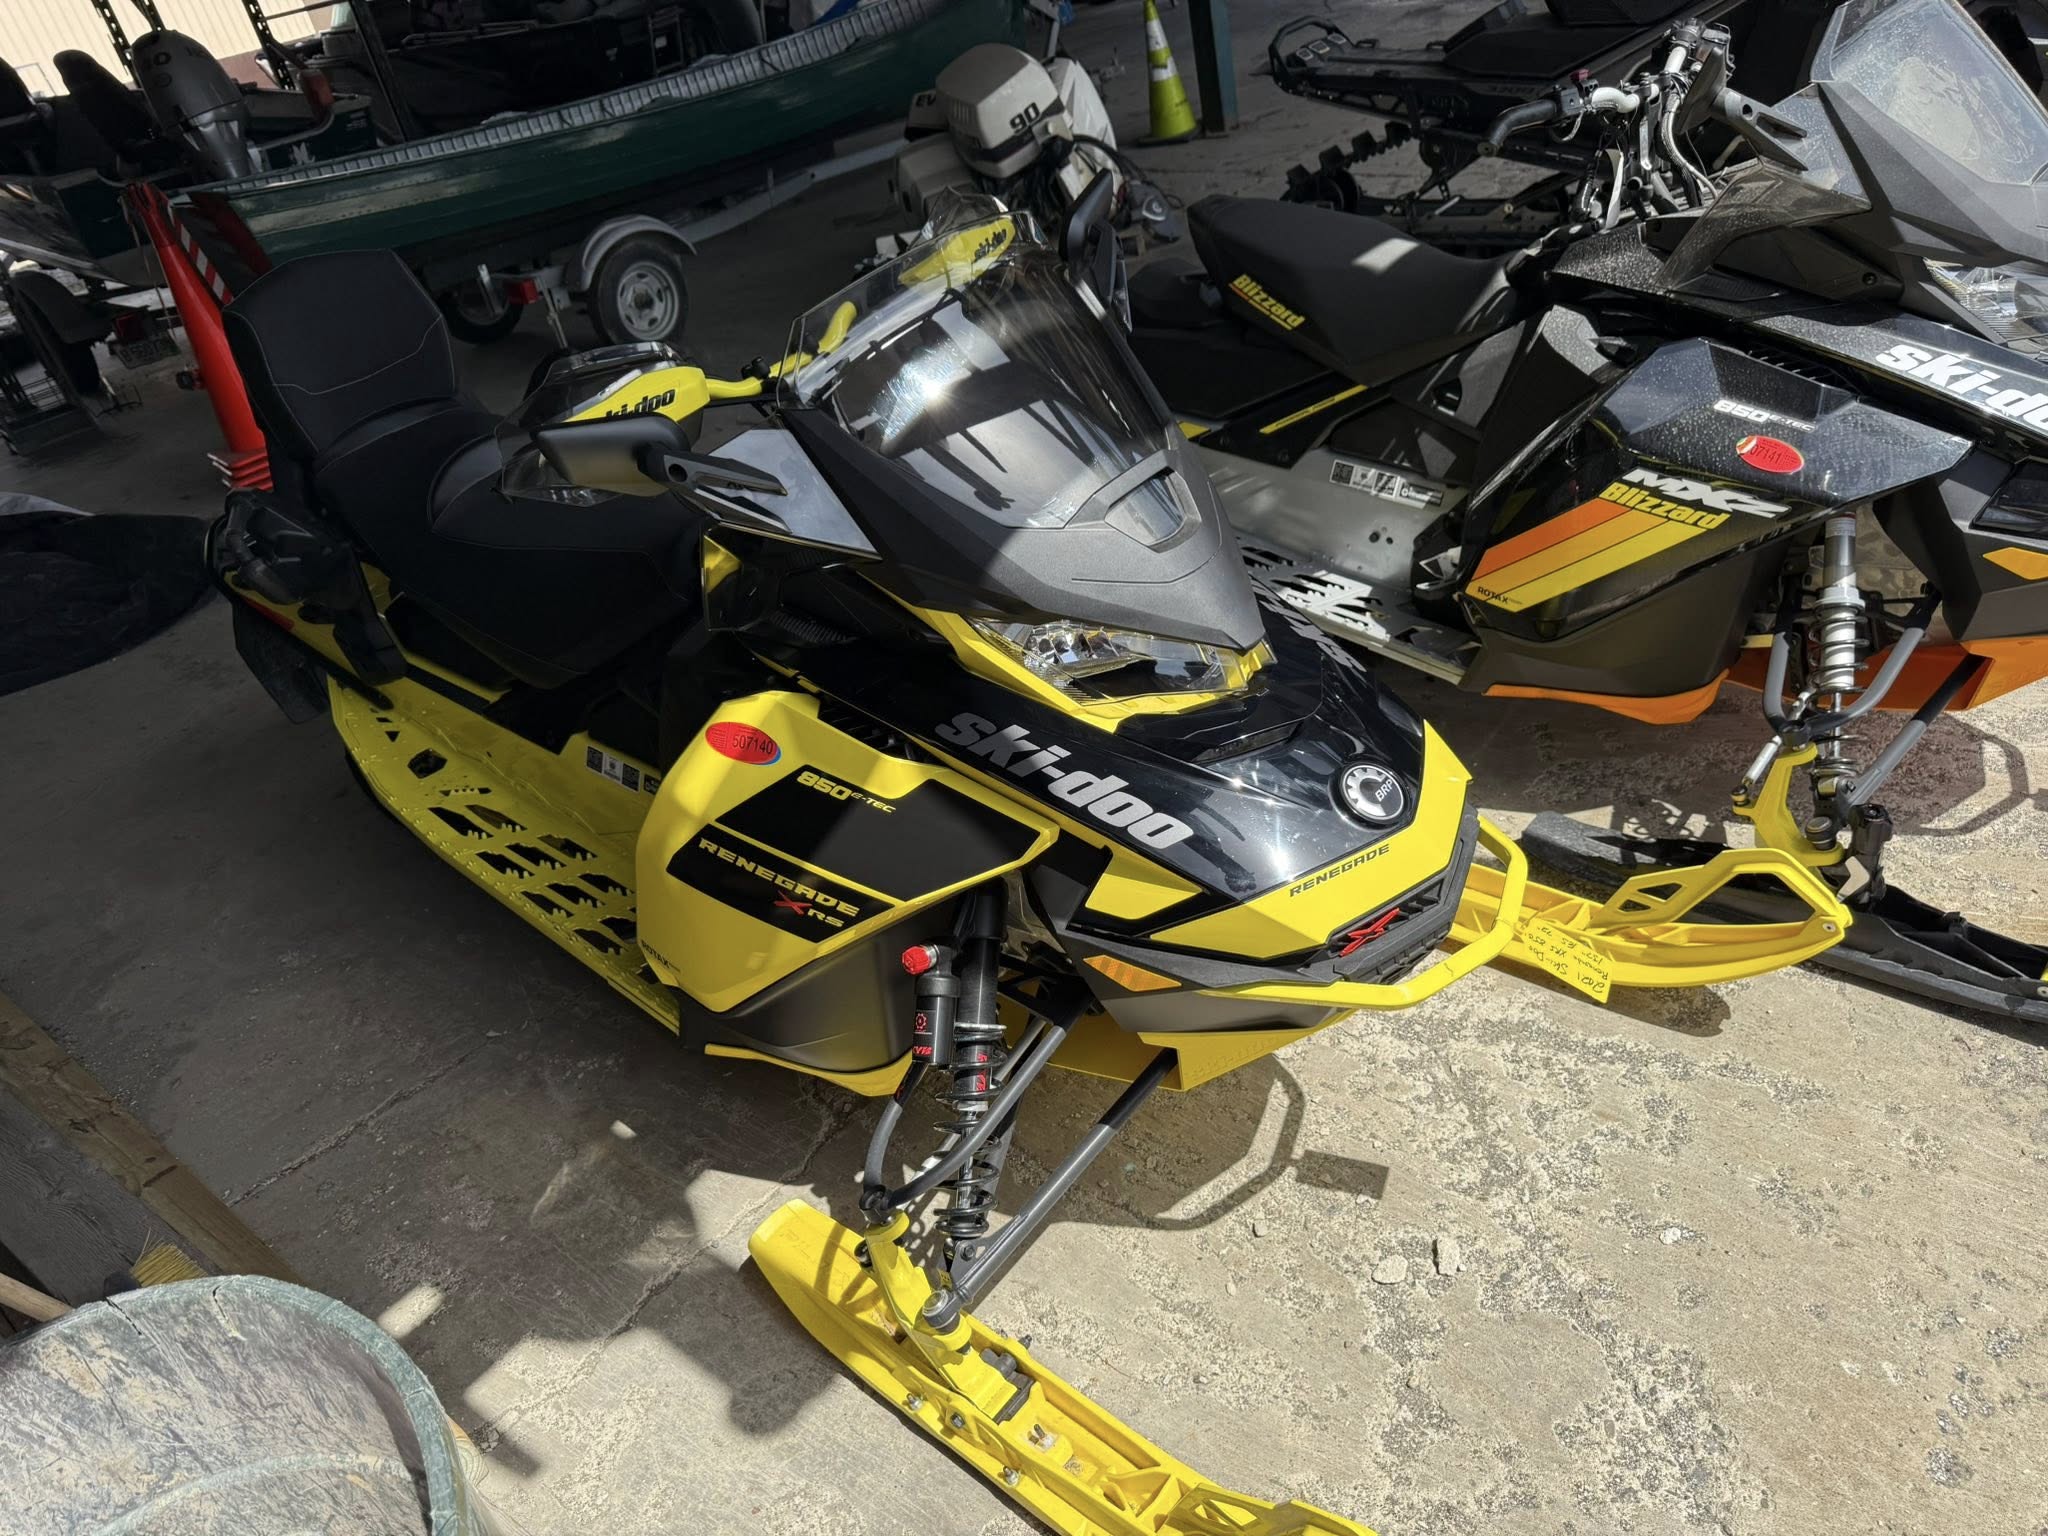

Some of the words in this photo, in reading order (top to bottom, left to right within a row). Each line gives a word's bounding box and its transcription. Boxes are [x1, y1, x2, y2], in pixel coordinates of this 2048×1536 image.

[1009, 102, 1040, 134] 90
[1232, 274, 1305, 328] Blizzard
[1713, 399, 1771, 423] 850
[1599, 481, 1731, 530] Blizzard
[797, 770, 853, 801] 850
[934, 712, 1195, 850] ski-doo
[1374, 778, 1393, 802] BRP
[698, 837, 860, 917] RENEGADE
[1289, 843, 1390, 898] RENEGADE
